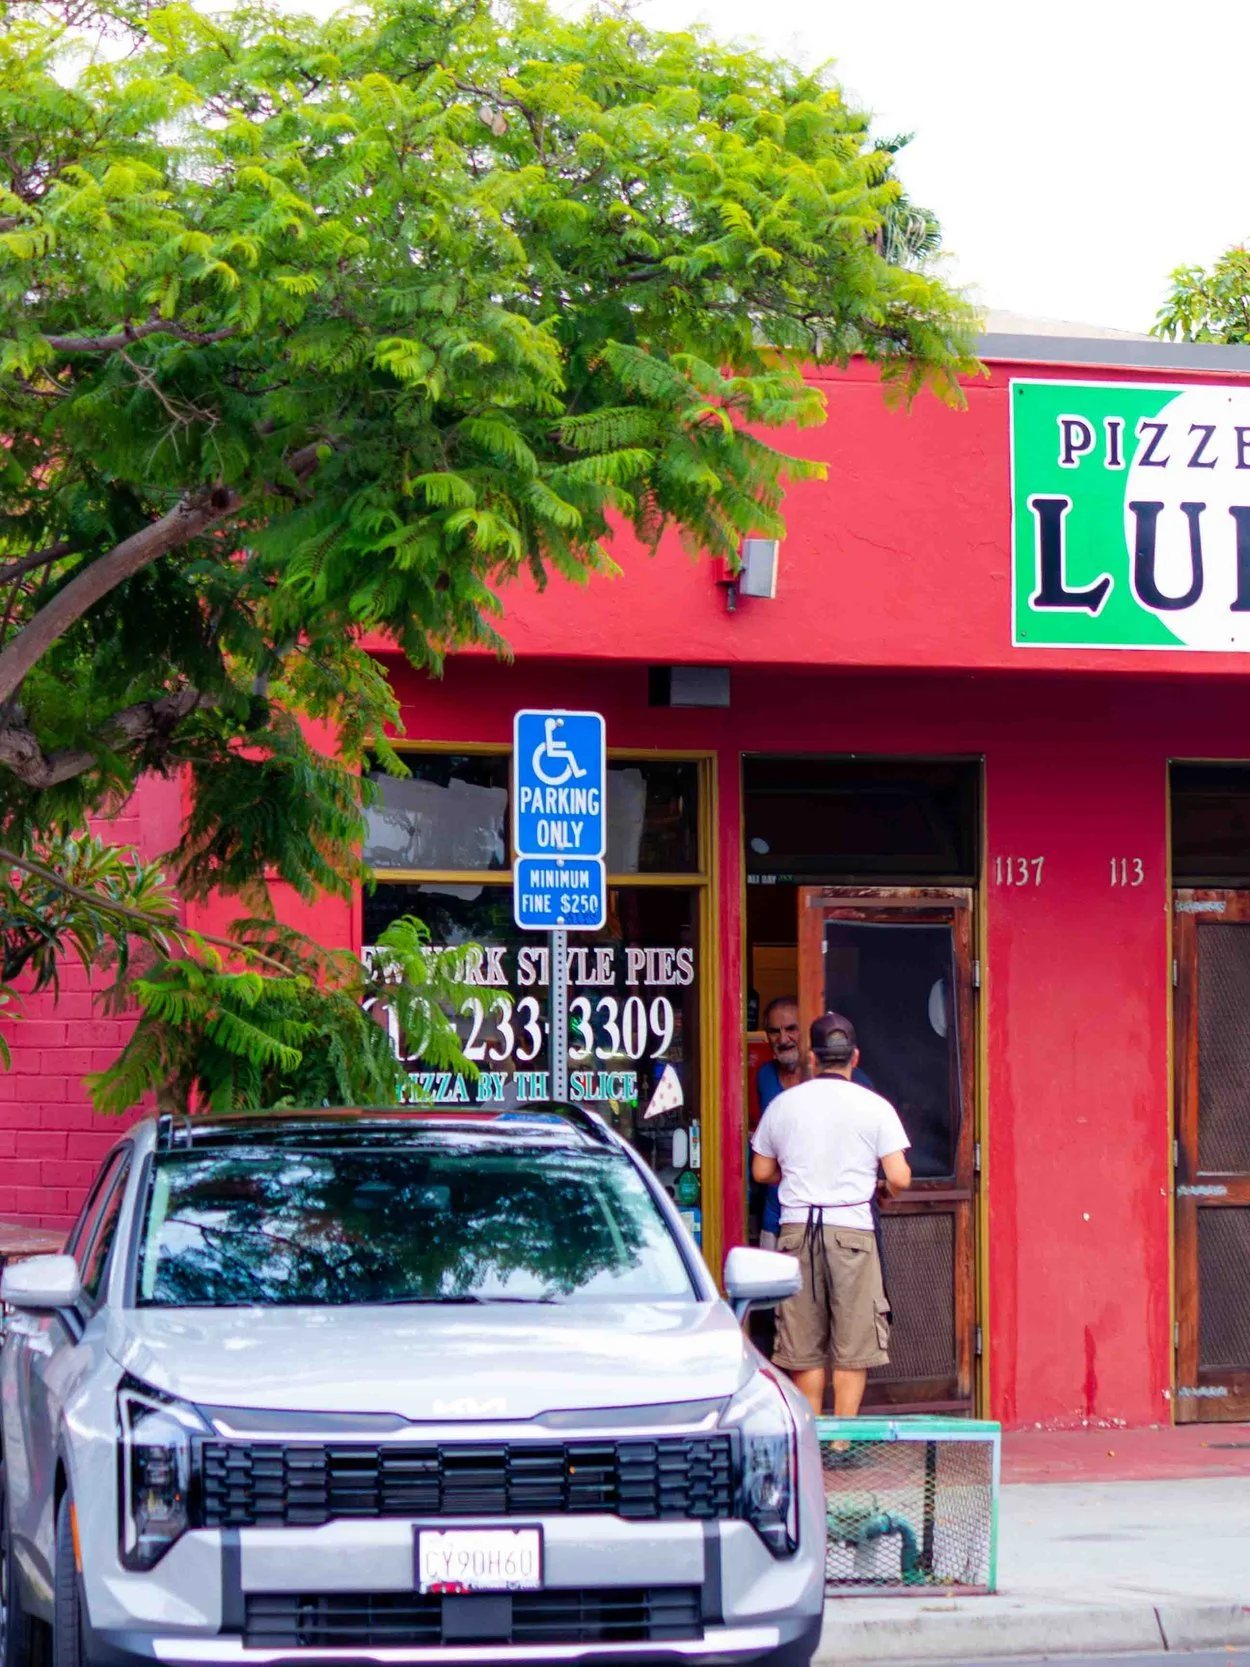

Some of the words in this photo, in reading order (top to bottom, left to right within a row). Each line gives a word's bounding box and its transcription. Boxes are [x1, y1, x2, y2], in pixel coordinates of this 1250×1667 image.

[520, 786, 600, 815] PARKING
[536, 819, 584, 848] ONLY
[530, 869, 589, 889] MINIMUM
[995, 856, 1044, 887] 1137
[1109, 857, 1144, 887] 113
[522, 894, 551, 913] FINE
[560, 893, 599, 914] $250
[625, 947, 695, 986] PIES
[476, 1071, 508, 1102] BY
[513, 1071, 550, 1102] TH
[570, 1071, 638, 1102] SLICE
